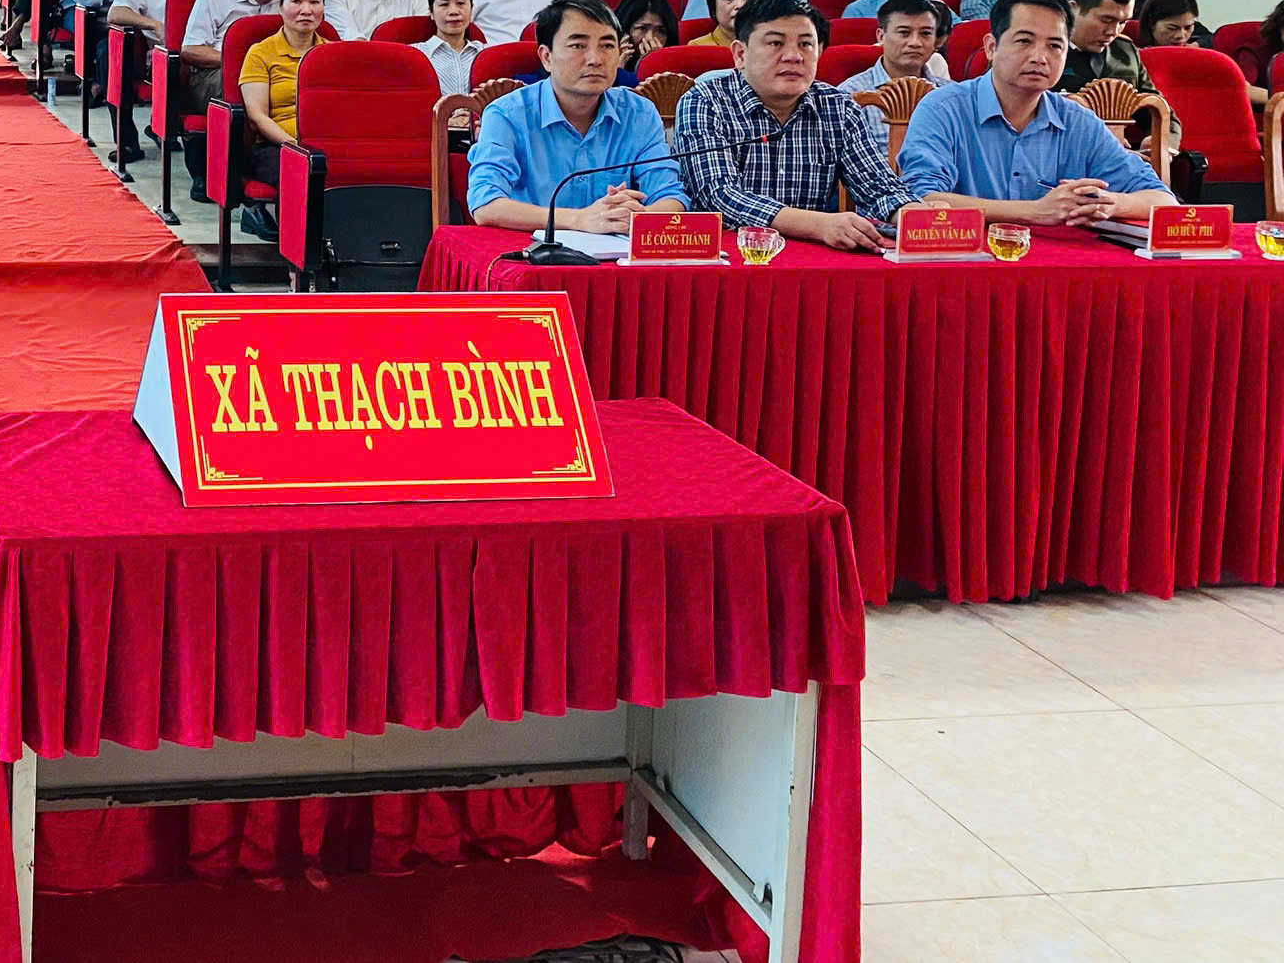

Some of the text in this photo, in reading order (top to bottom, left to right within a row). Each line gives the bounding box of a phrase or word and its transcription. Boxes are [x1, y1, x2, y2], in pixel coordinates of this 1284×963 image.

[205, 341, 564, 452] XÃ THẠCH BÌNH
